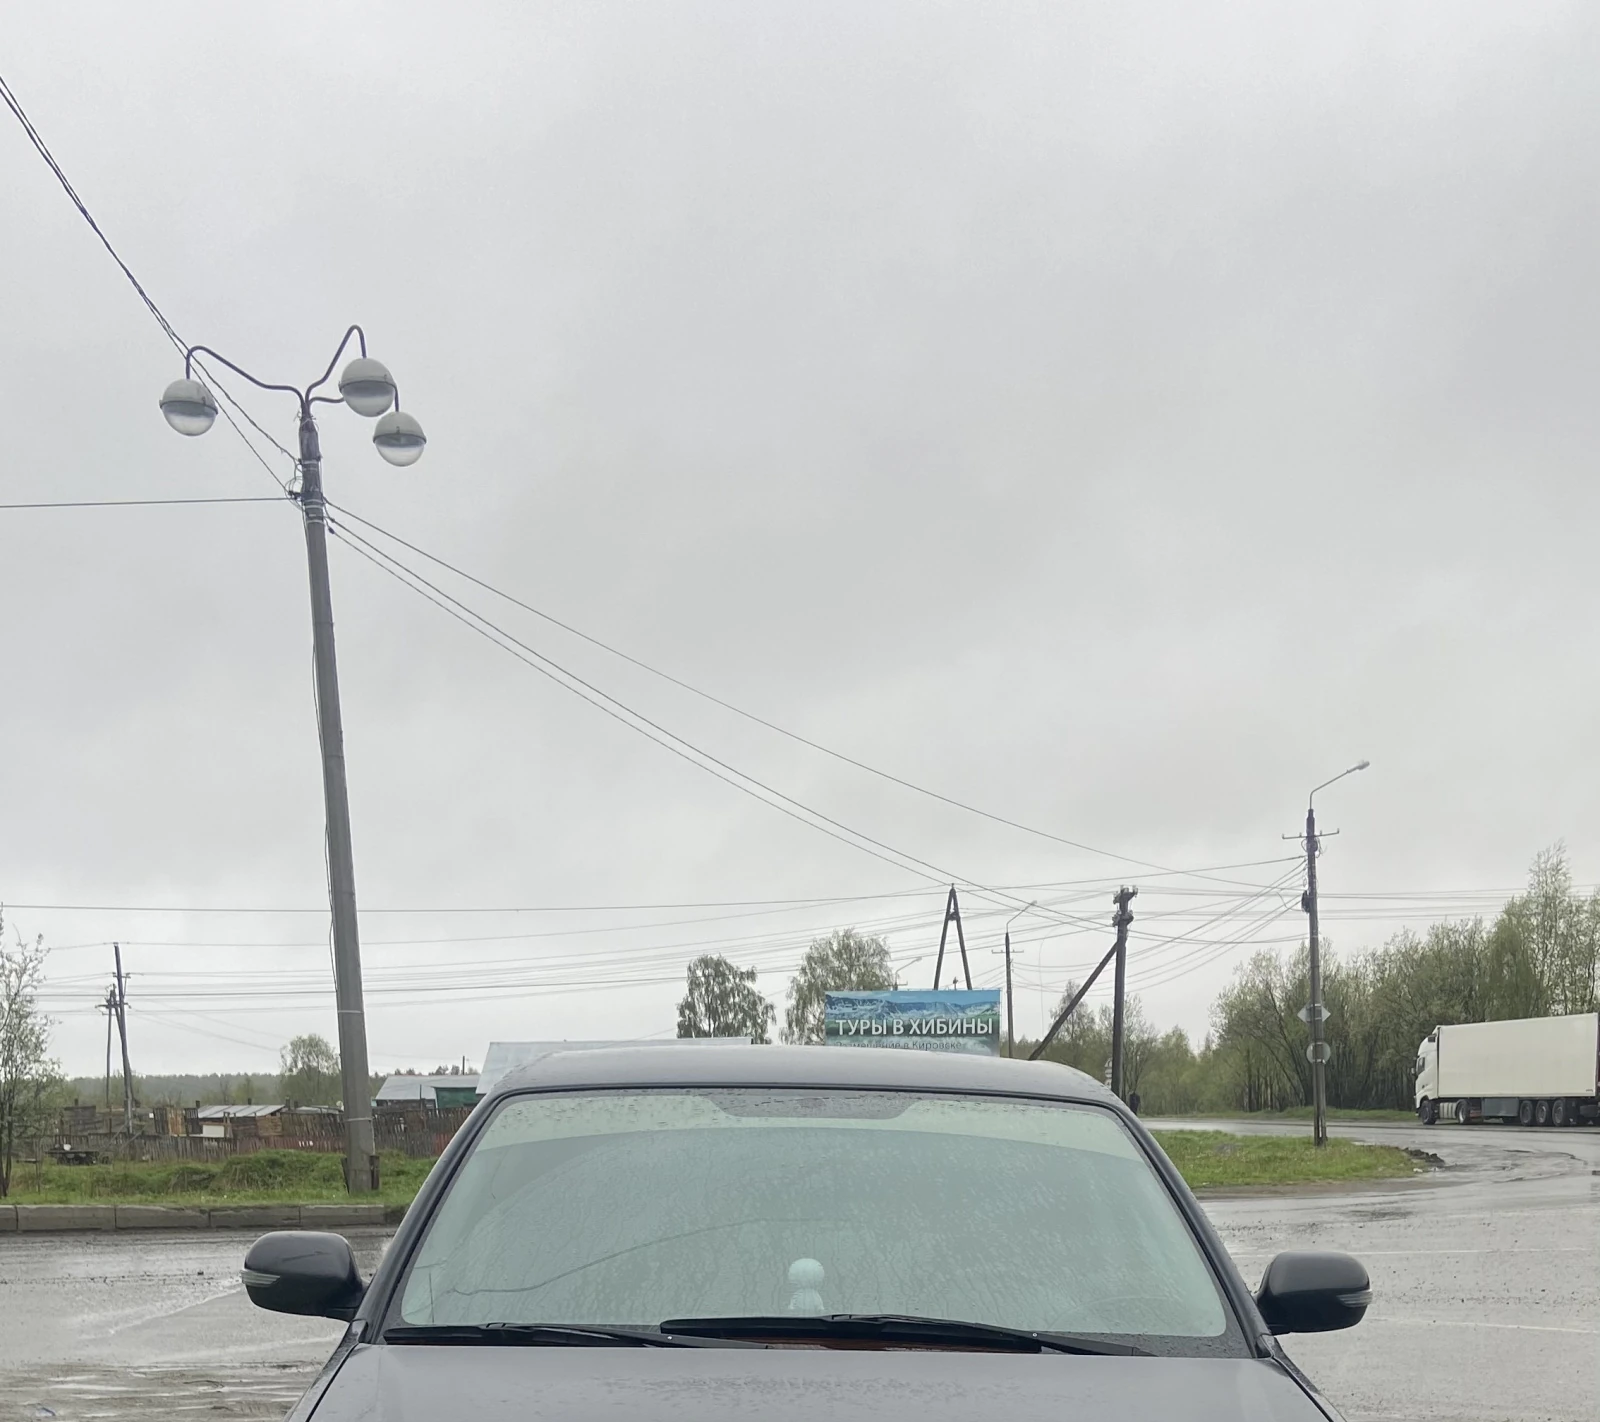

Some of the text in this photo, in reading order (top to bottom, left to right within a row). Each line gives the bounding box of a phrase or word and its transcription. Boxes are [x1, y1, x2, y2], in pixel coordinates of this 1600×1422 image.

[835, 1018, 993, 1036] ТУРЫ В ХИБИНЫ
